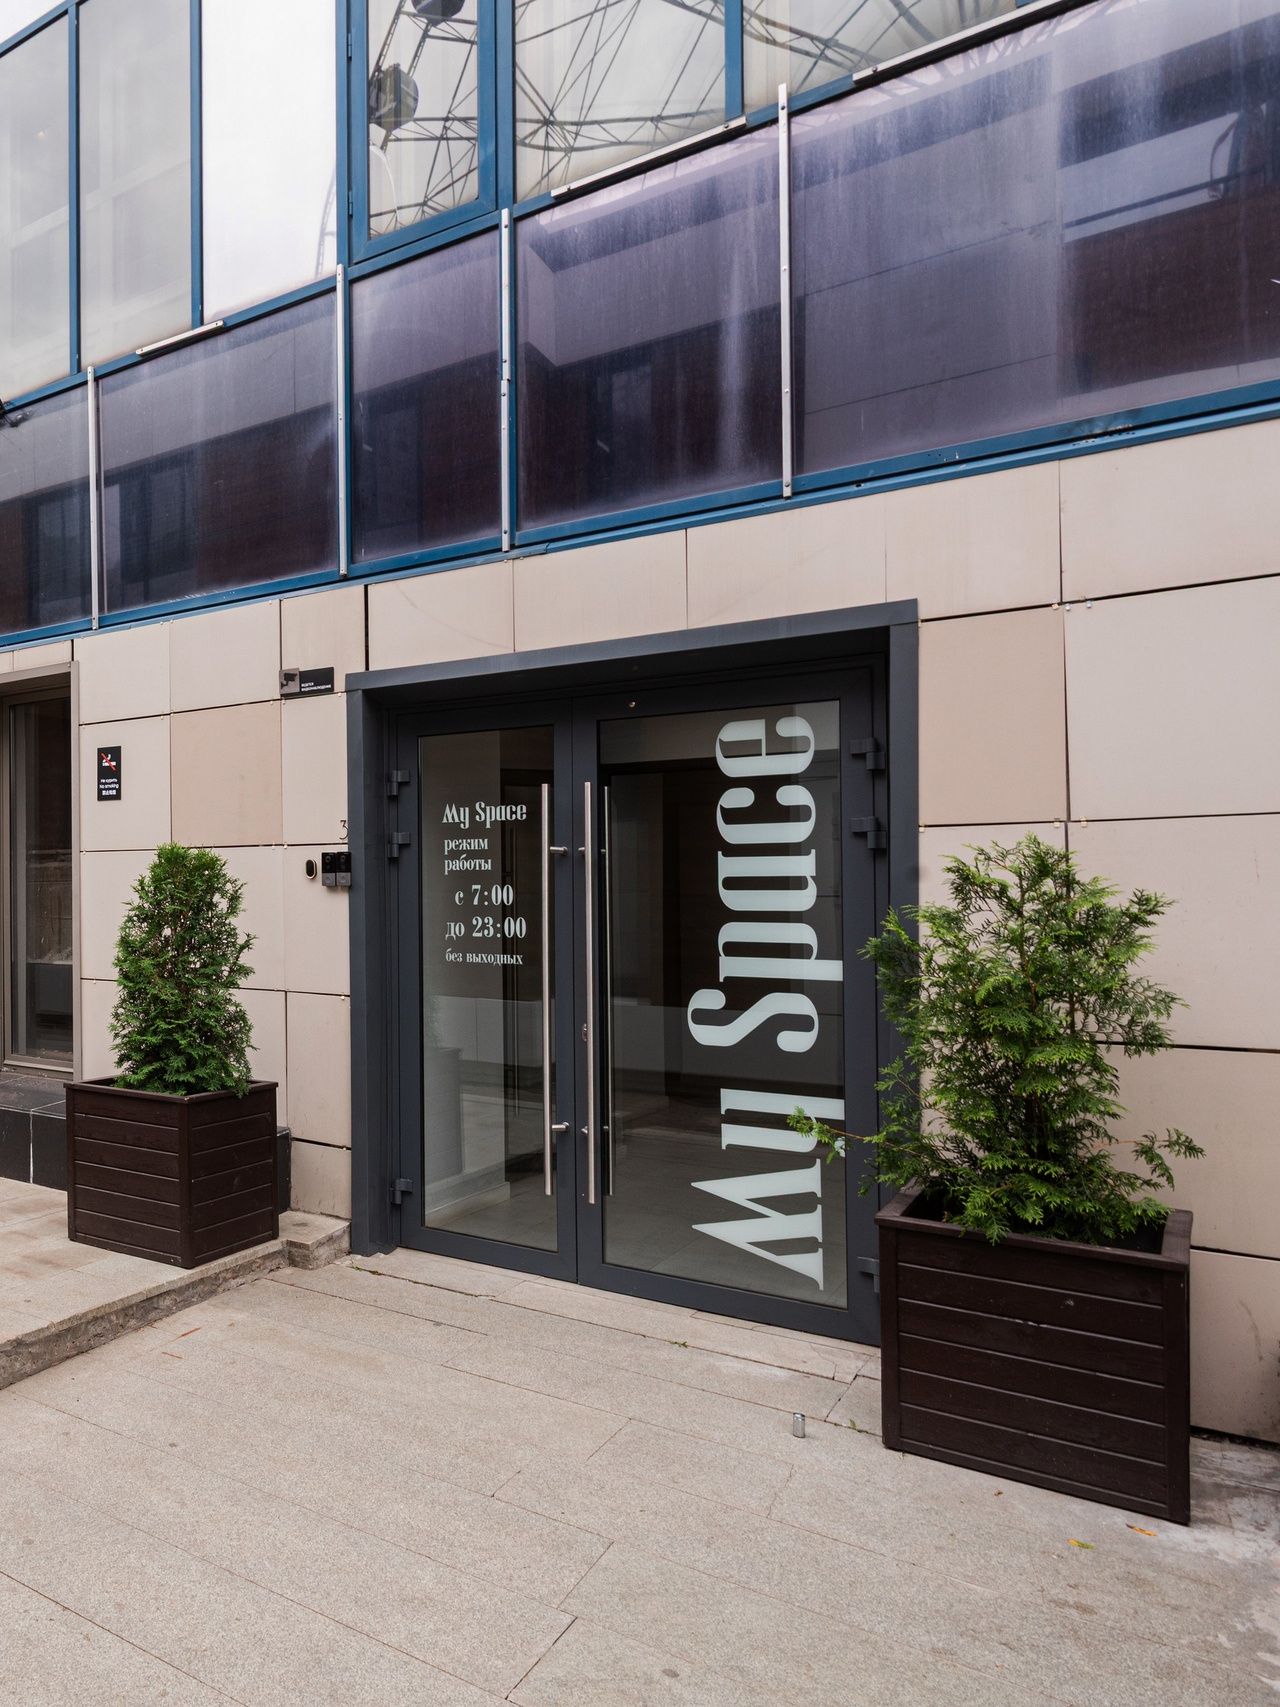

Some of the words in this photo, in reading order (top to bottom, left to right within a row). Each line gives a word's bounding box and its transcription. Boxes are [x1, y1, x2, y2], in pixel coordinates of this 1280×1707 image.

[441, 803, 470, 829] My
[475, 801, 527, 828] Space
[444, 838, 488, 854] режим
[444, 854, 492, 875] работы
[454, 890, 464, 905] с
[471, 884, 514, 906] 7:00
[686, 715, 844, 1054] Space
[445, 921, 465, 940] до
[472, 916, 527, 938] 23:00
[445, 948, 463, 962] без
[466, 952, 523, 966] выходных
[690, 1087, 846, 1291] My
